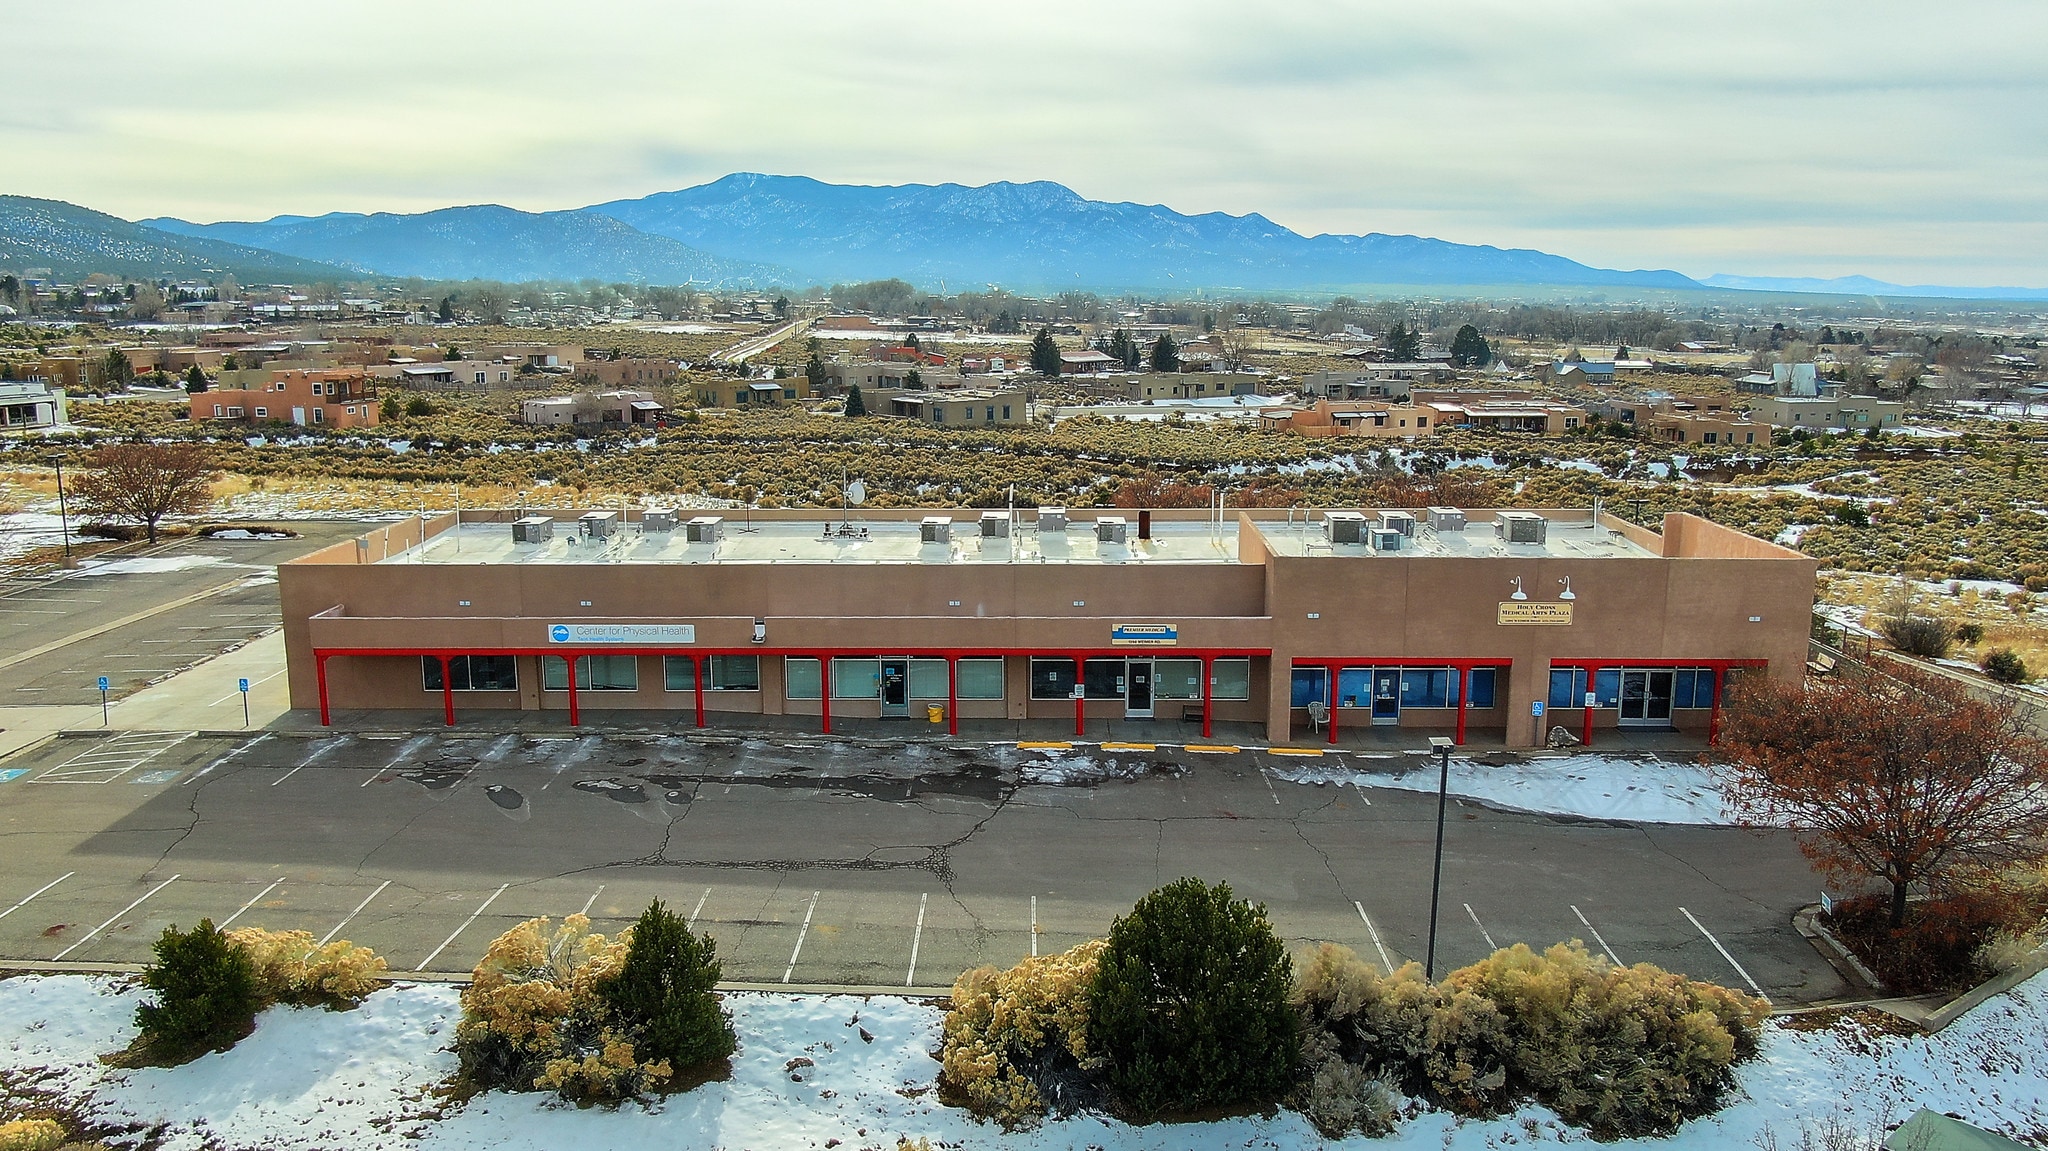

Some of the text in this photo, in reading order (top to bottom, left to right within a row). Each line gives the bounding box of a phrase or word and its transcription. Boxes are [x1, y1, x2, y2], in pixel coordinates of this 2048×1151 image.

[576, 626, 690, 637] Center for Physical Health
